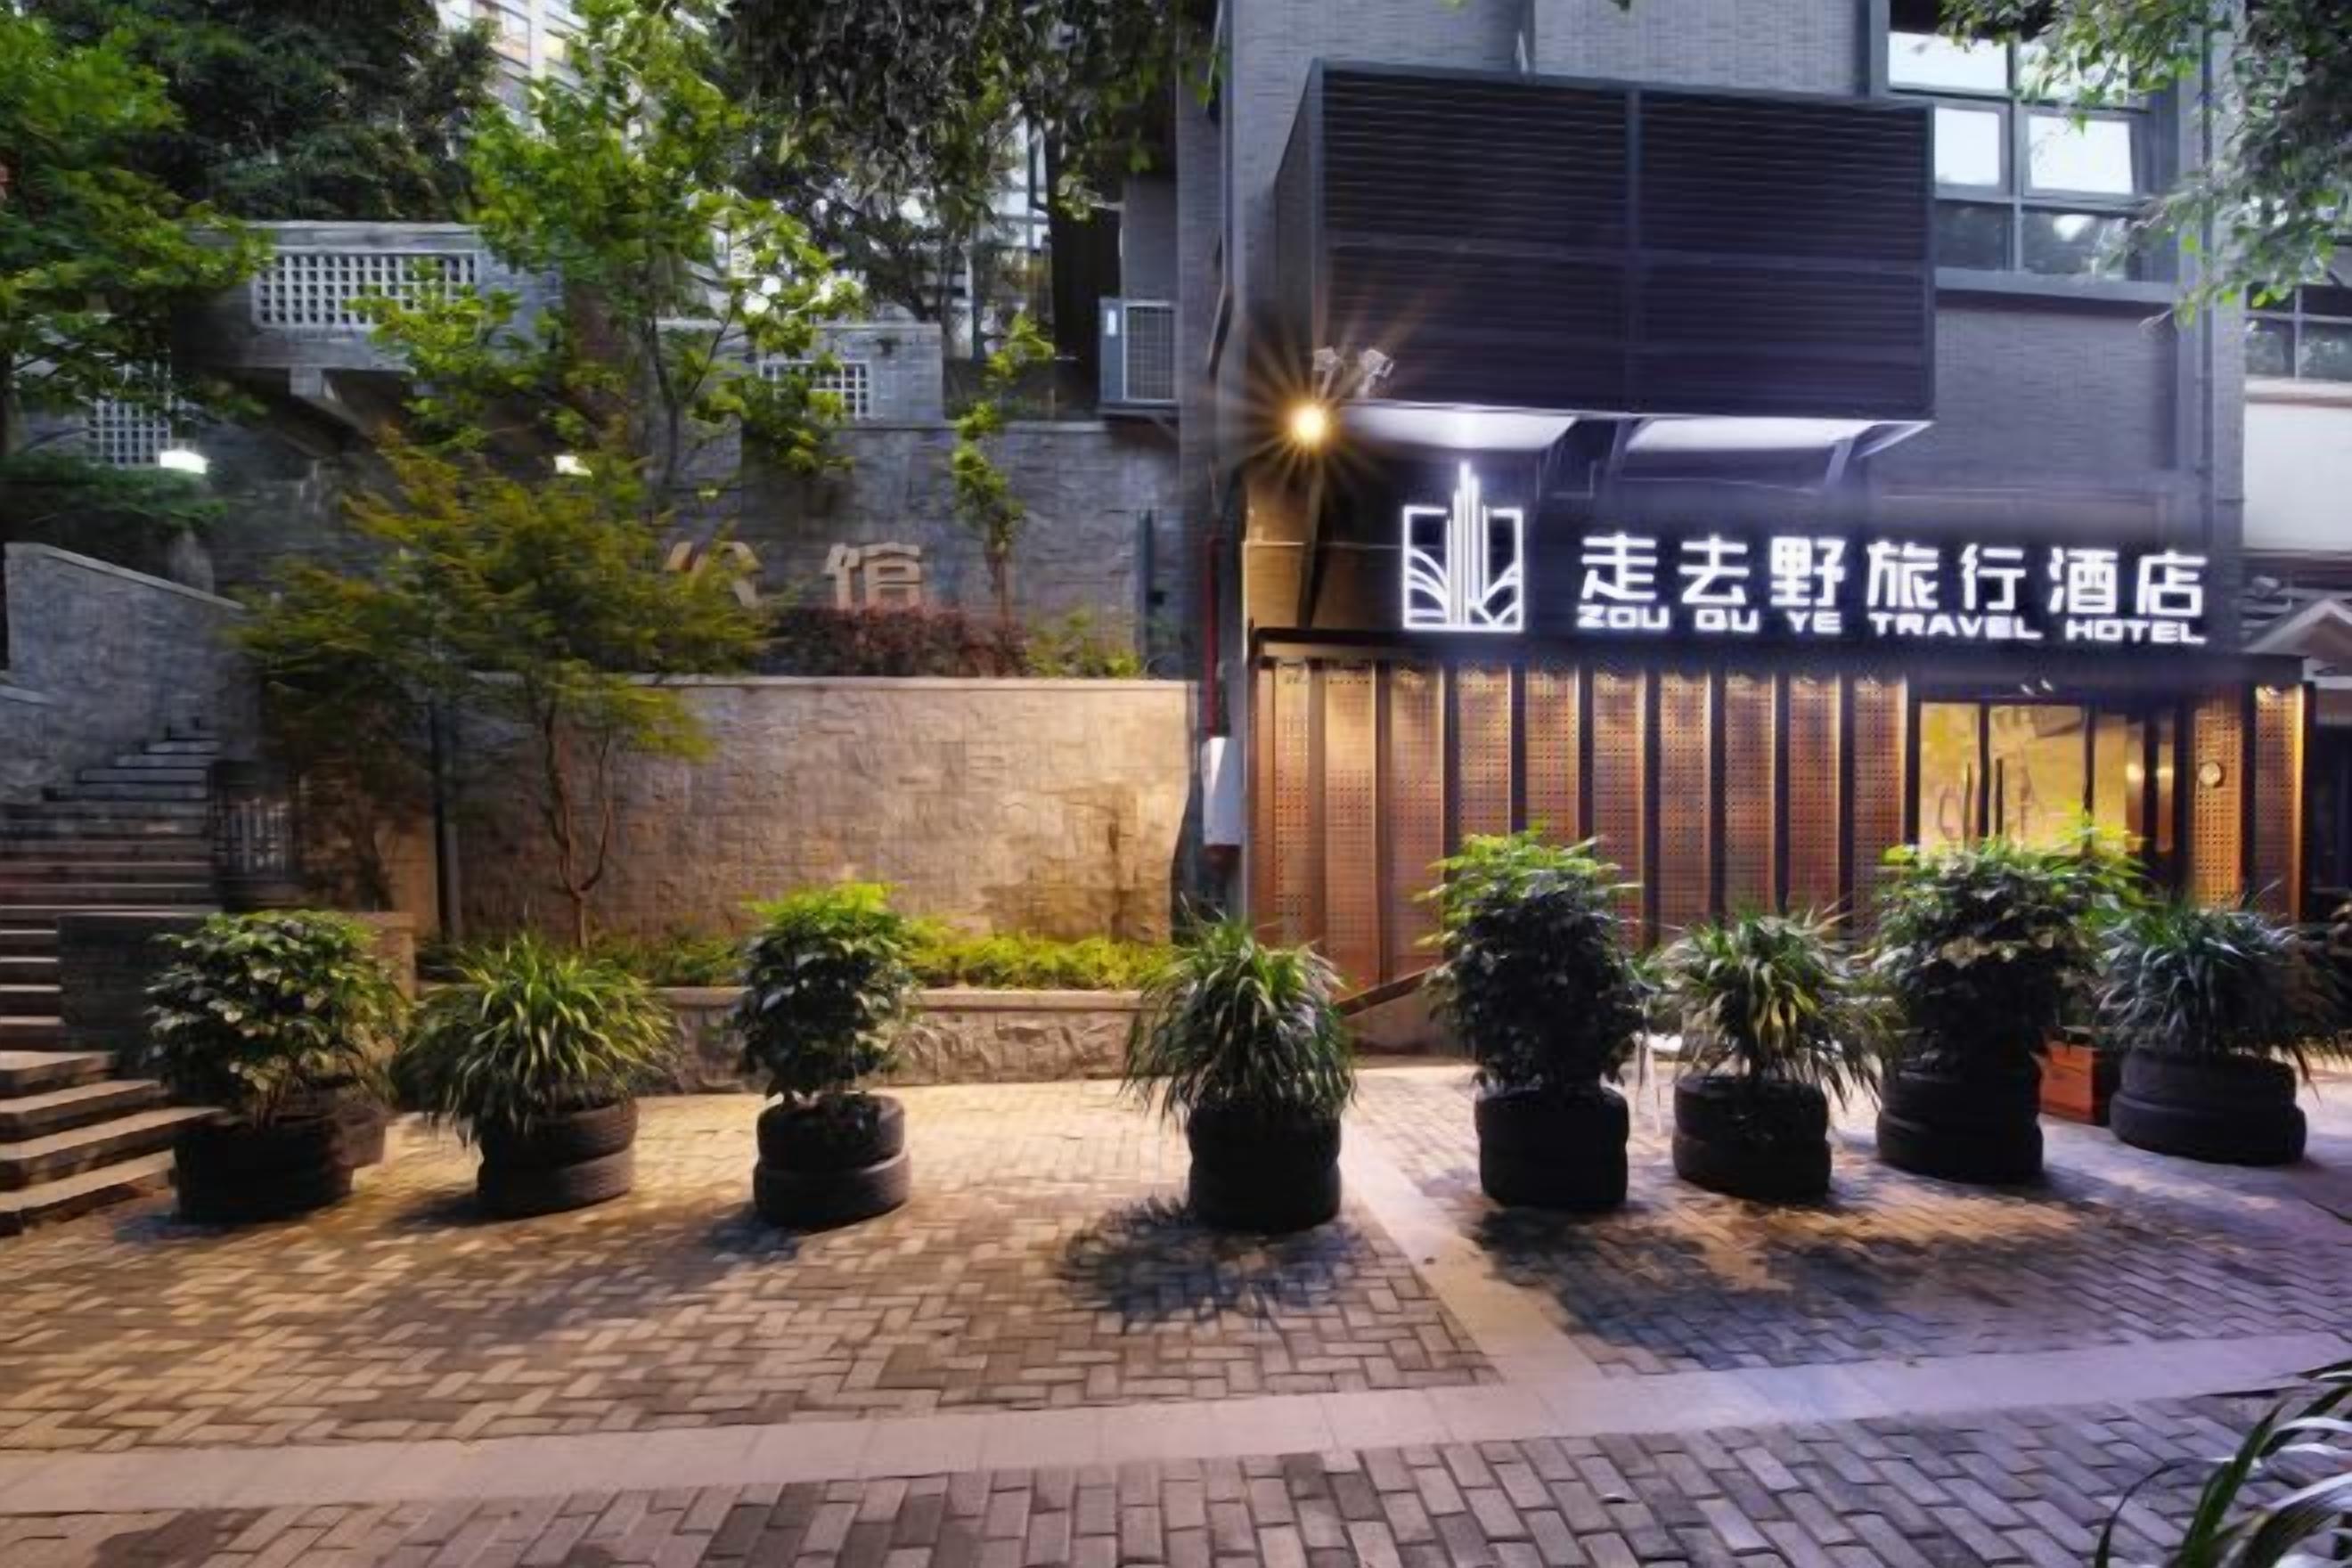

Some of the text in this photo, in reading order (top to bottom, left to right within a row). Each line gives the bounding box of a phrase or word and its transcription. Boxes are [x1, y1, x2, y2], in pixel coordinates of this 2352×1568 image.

[1580, 532, 2209, 616] 走去野旅行酒店
[1577, 604, 1670, 630] ZOU
[1785, 610, 1842, 634] YE
[1867, 611, 2044, 640] TRAVEL
[2065, 618, 2208, 644] HOTEL
